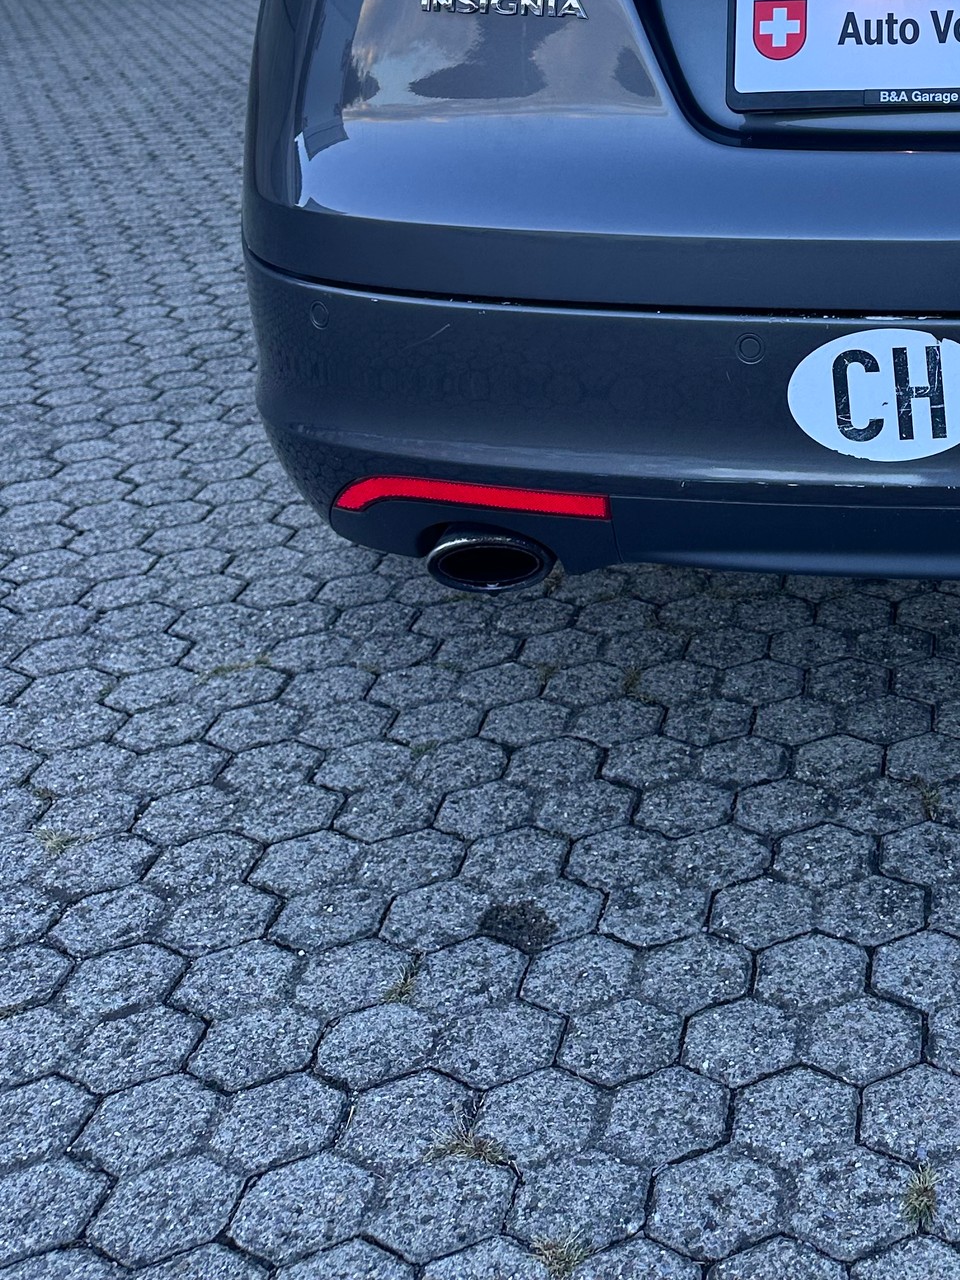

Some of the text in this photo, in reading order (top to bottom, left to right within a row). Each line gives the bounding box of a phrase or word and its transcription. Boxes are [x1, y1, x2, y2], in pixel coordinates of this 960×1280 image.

[837, 11, 920, 46] Auto
[880, 91, 908, 102] B&A
[911, 91, 959, 104] Garage
[832, 346, 948, 443] CH
